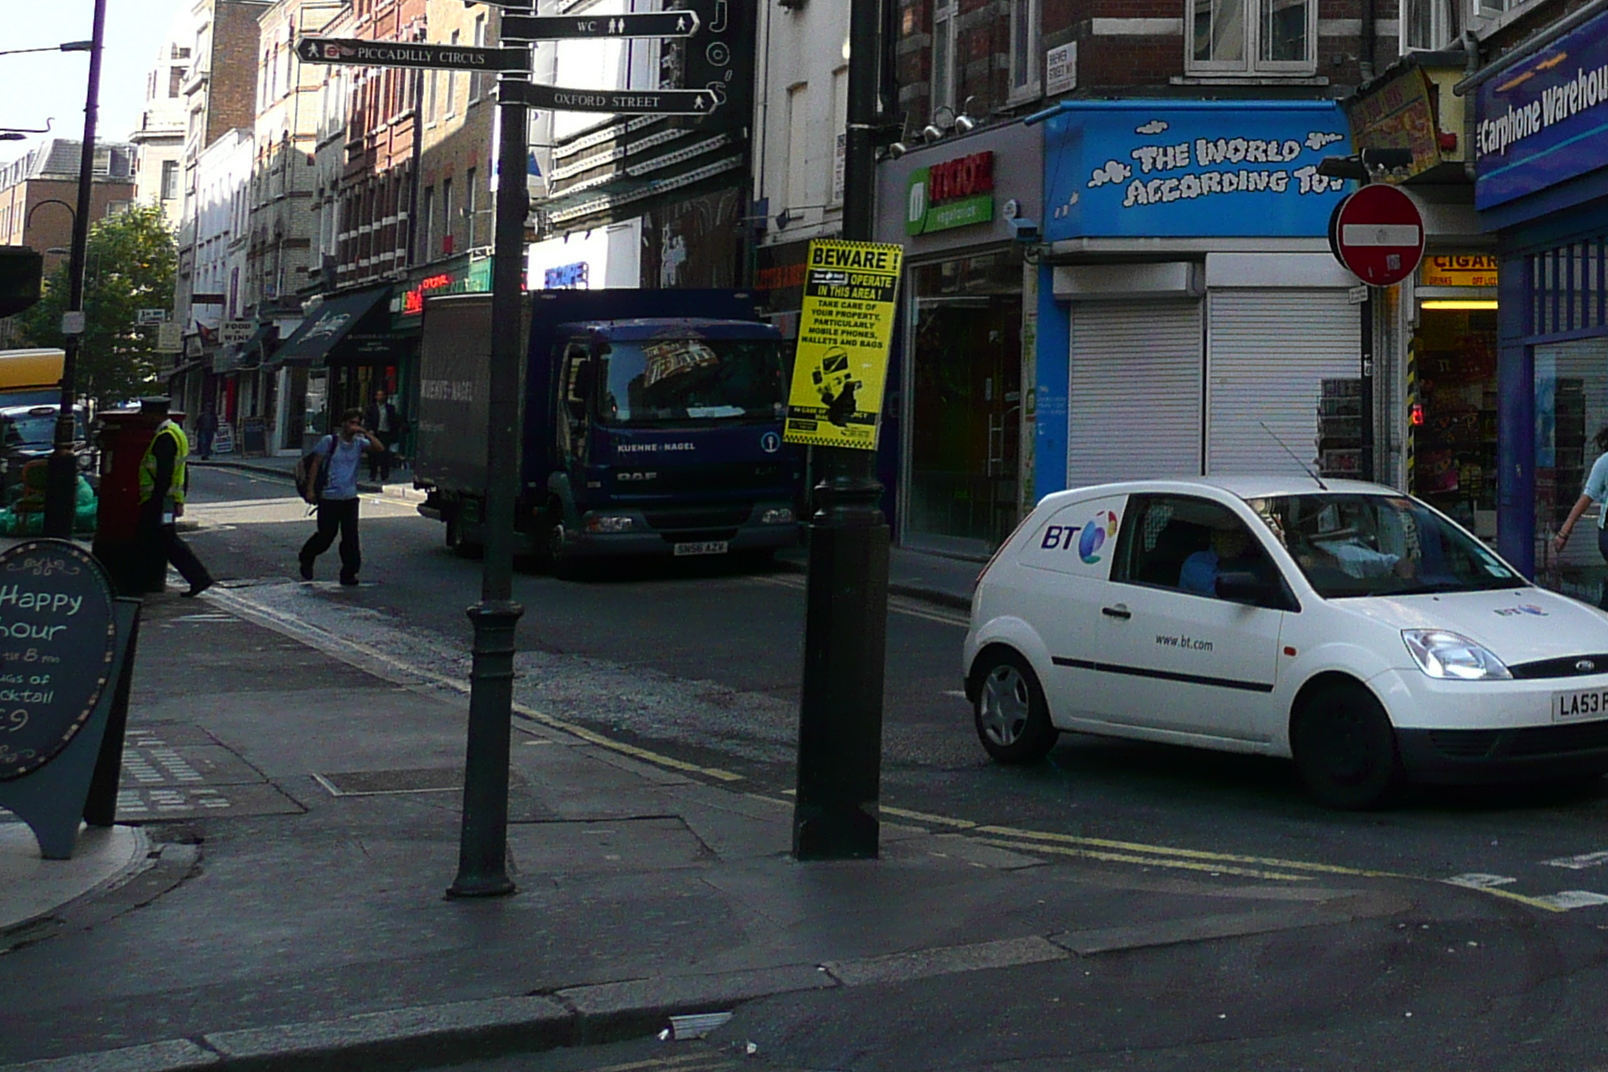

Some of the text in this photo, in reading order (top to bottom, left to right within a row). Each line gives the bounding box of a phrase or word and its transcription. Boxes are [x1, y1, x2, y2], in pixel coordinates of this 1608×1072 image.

[577, 21, 598, 32] WC
[358, 46, 485, 65] PICCADILLY CIRCUS
[554, 92, 661, 108] OXFORD STREET
[1481, 100, 1541, 156] Carphone
[1132, 137, 1301, 174] THE WORLD
[1122, 170, 1289, 208] ACCORDING
[812, 248, 888, 269] BEWARE
[850, 274, 893, 288] OPERATE
[817, 286, 827, 296] IN
[830, 286, 850, 298] THIS
[851, 288, 876, 299] AREA
[811, 309, 833, 317] YOUR
[818, 300, 838, 308] TAKE
[841, 302, 863, 310] CARE
[808, 327, 838, 336] MOBILE
[814, 318, 875, 329] PARTICULARLY
[801, 336, 883, 348] WALLETS AND BAGS
[1041, 525, 1081, 550] BT
[0, 585, 83, 616] Happy
[1156, 634, 1213, 652] www.bt.com
[1560, 693, 1598, 716] LA53
